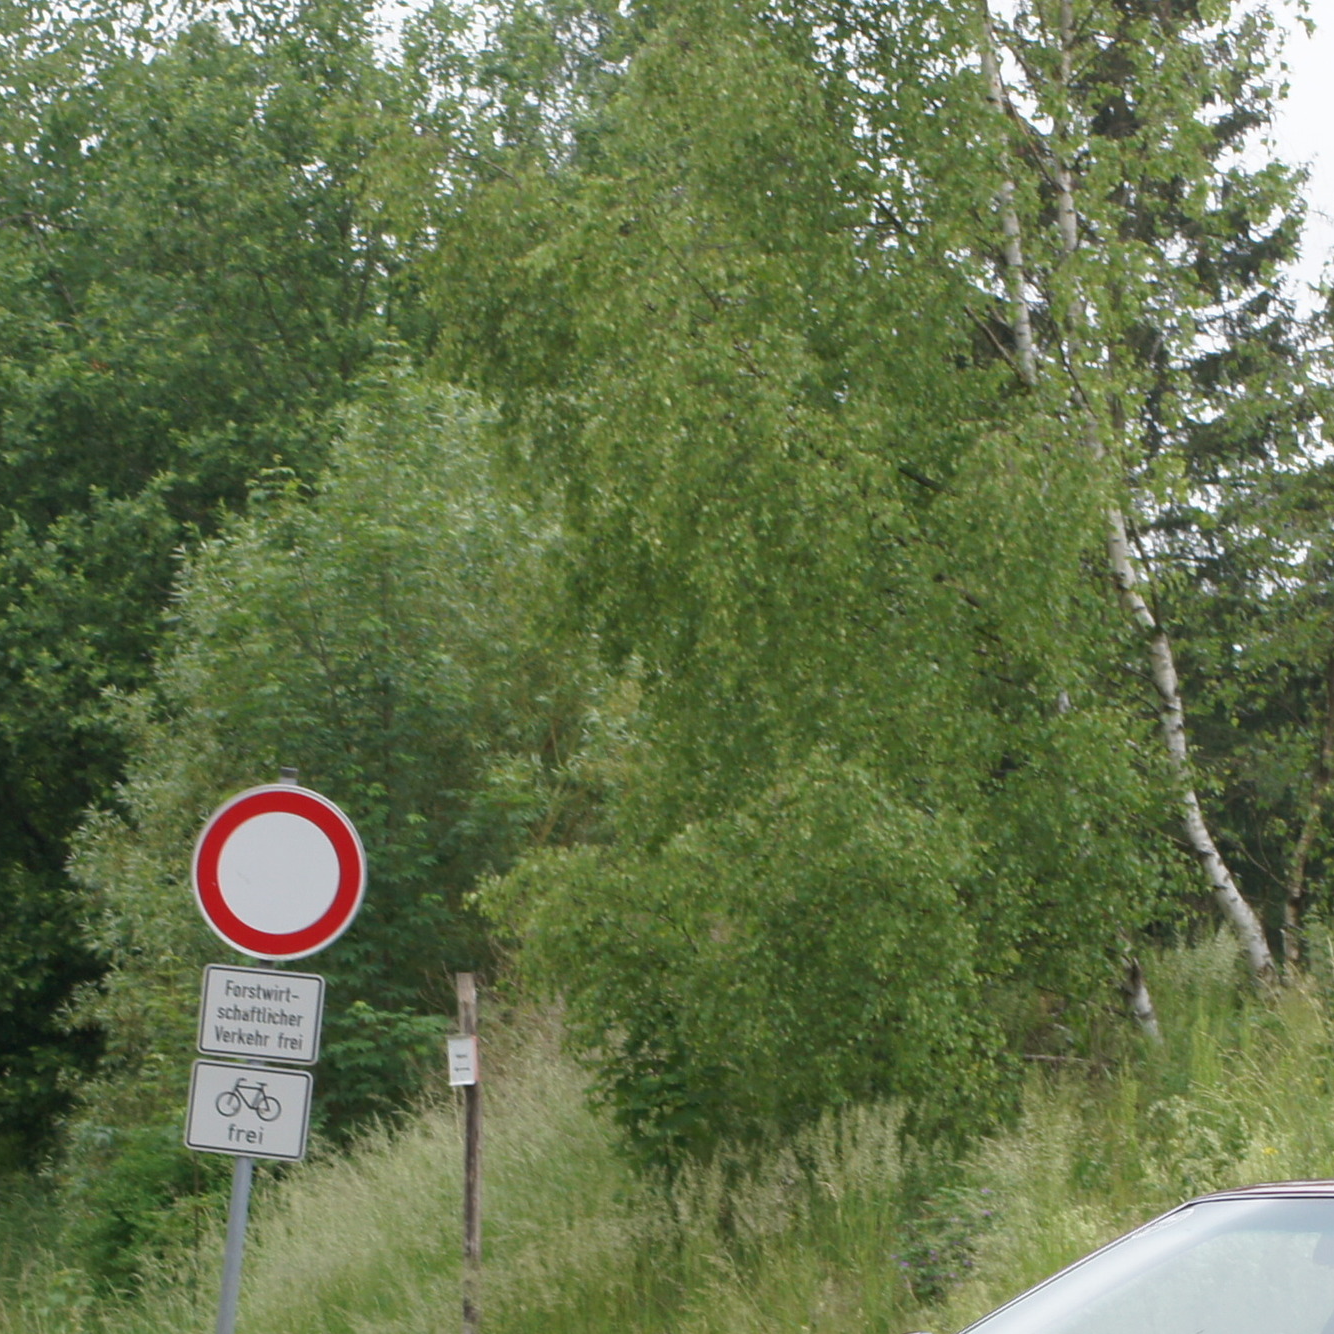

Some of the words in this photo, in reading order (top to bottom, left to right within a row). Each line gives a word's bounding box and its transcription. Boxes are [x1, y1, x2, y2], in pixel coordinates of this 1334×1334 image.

[225, 980, 300, 1003] Forstwirt-
[216, 1004, 304, 1027] schaftlicher
[214, 1025, 270, 1047] Verkehr
[277, 1032, 304, 1050] frei
[227, 1123, 265, 1145] frei
